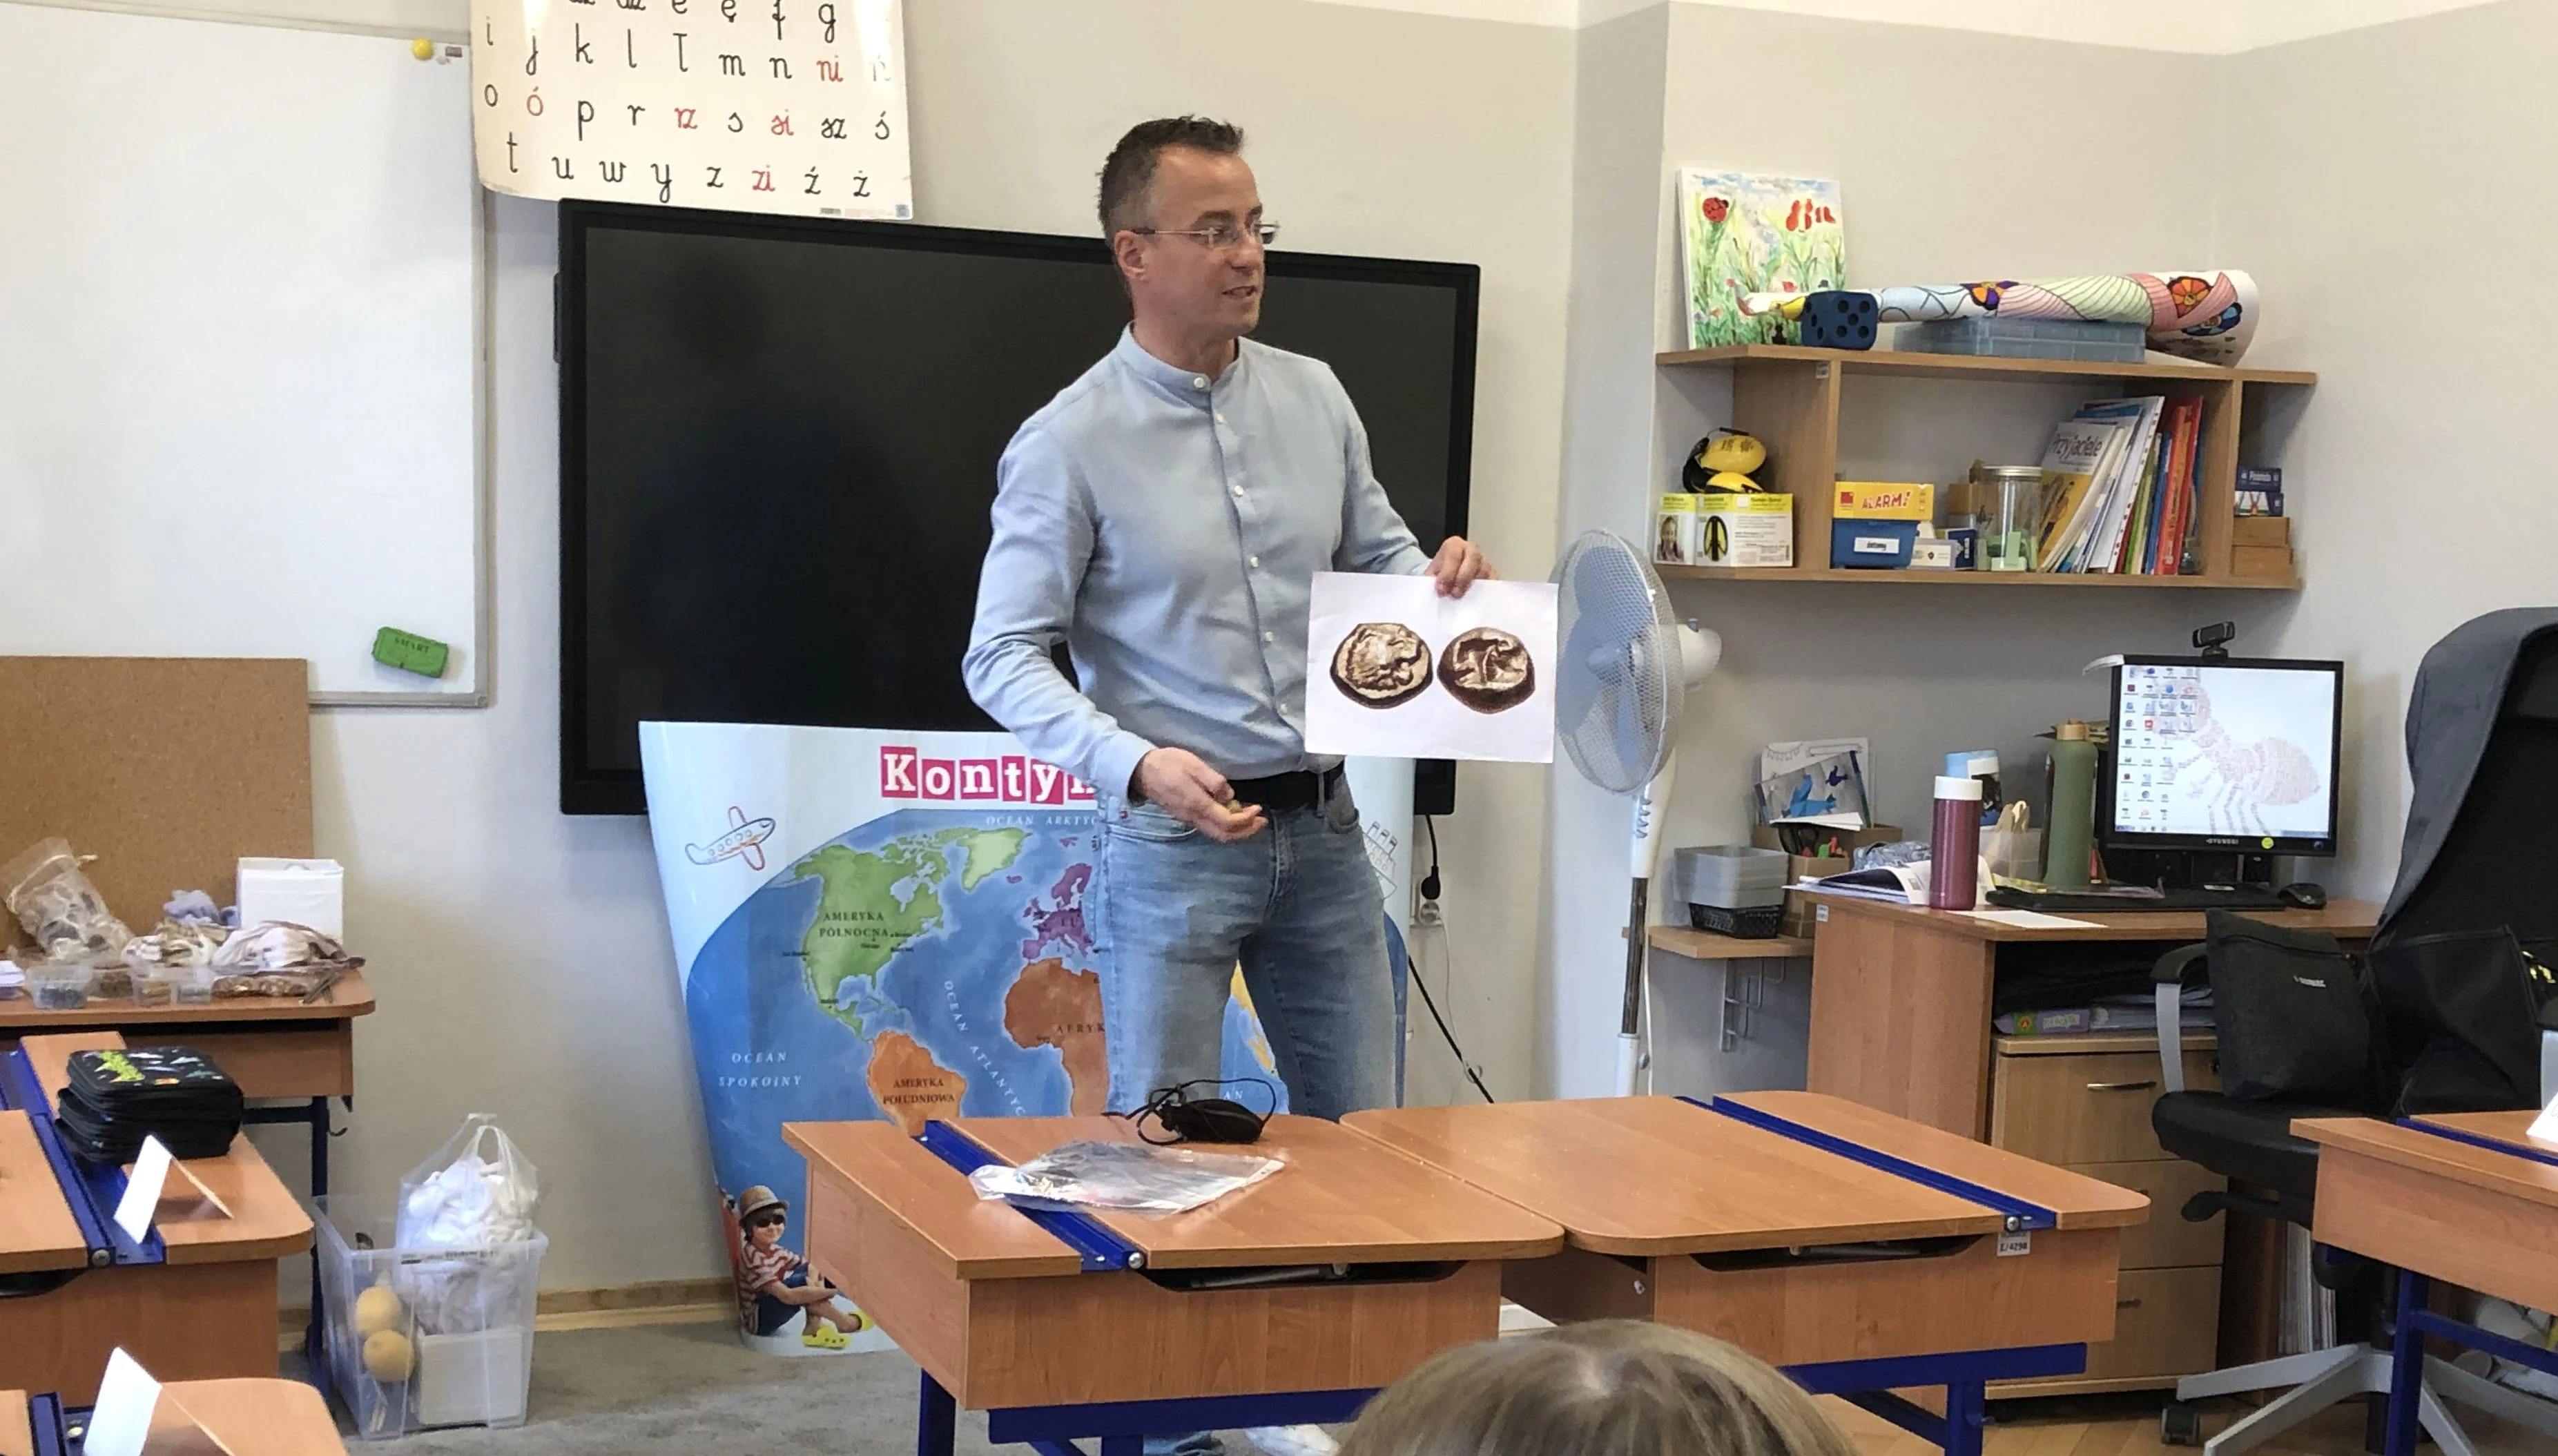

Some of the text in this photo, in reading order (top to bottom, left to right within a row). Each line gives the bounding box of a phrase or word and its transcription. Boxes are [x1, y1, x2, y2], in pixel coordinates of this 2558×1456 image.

[818, 3, 836, 43] g
[575, 23, 594, 64] k
[718, 54, 746, 77] m
[769, 57, 793, 79] n
[816, 55, 844, 82] ni
[484, 84, 498, 107] o
[527, 86, 543, 116] ó
[578, 100, 594, 142] p
[627, 105, 646, 126] r
[675, 108, 697, 129] rz
[507, 131, 871, 203] t u w y z zi ź ż
[1862, 492, 1911, 509] ALARM!
[986, 815, 1034, 826] OCEAN
[823, 911, 884, 922] AMERYKA
[819, 927, 889, 938] PÓŁNOCNA
[944, 980, 968, 1031] OCEAN
[731, 1052, 787, 1063] OCEAN
[893, 1078, 944, 1088] AMERYKA
[883, 1094, 955, 1105] POŁUDNIOWA
